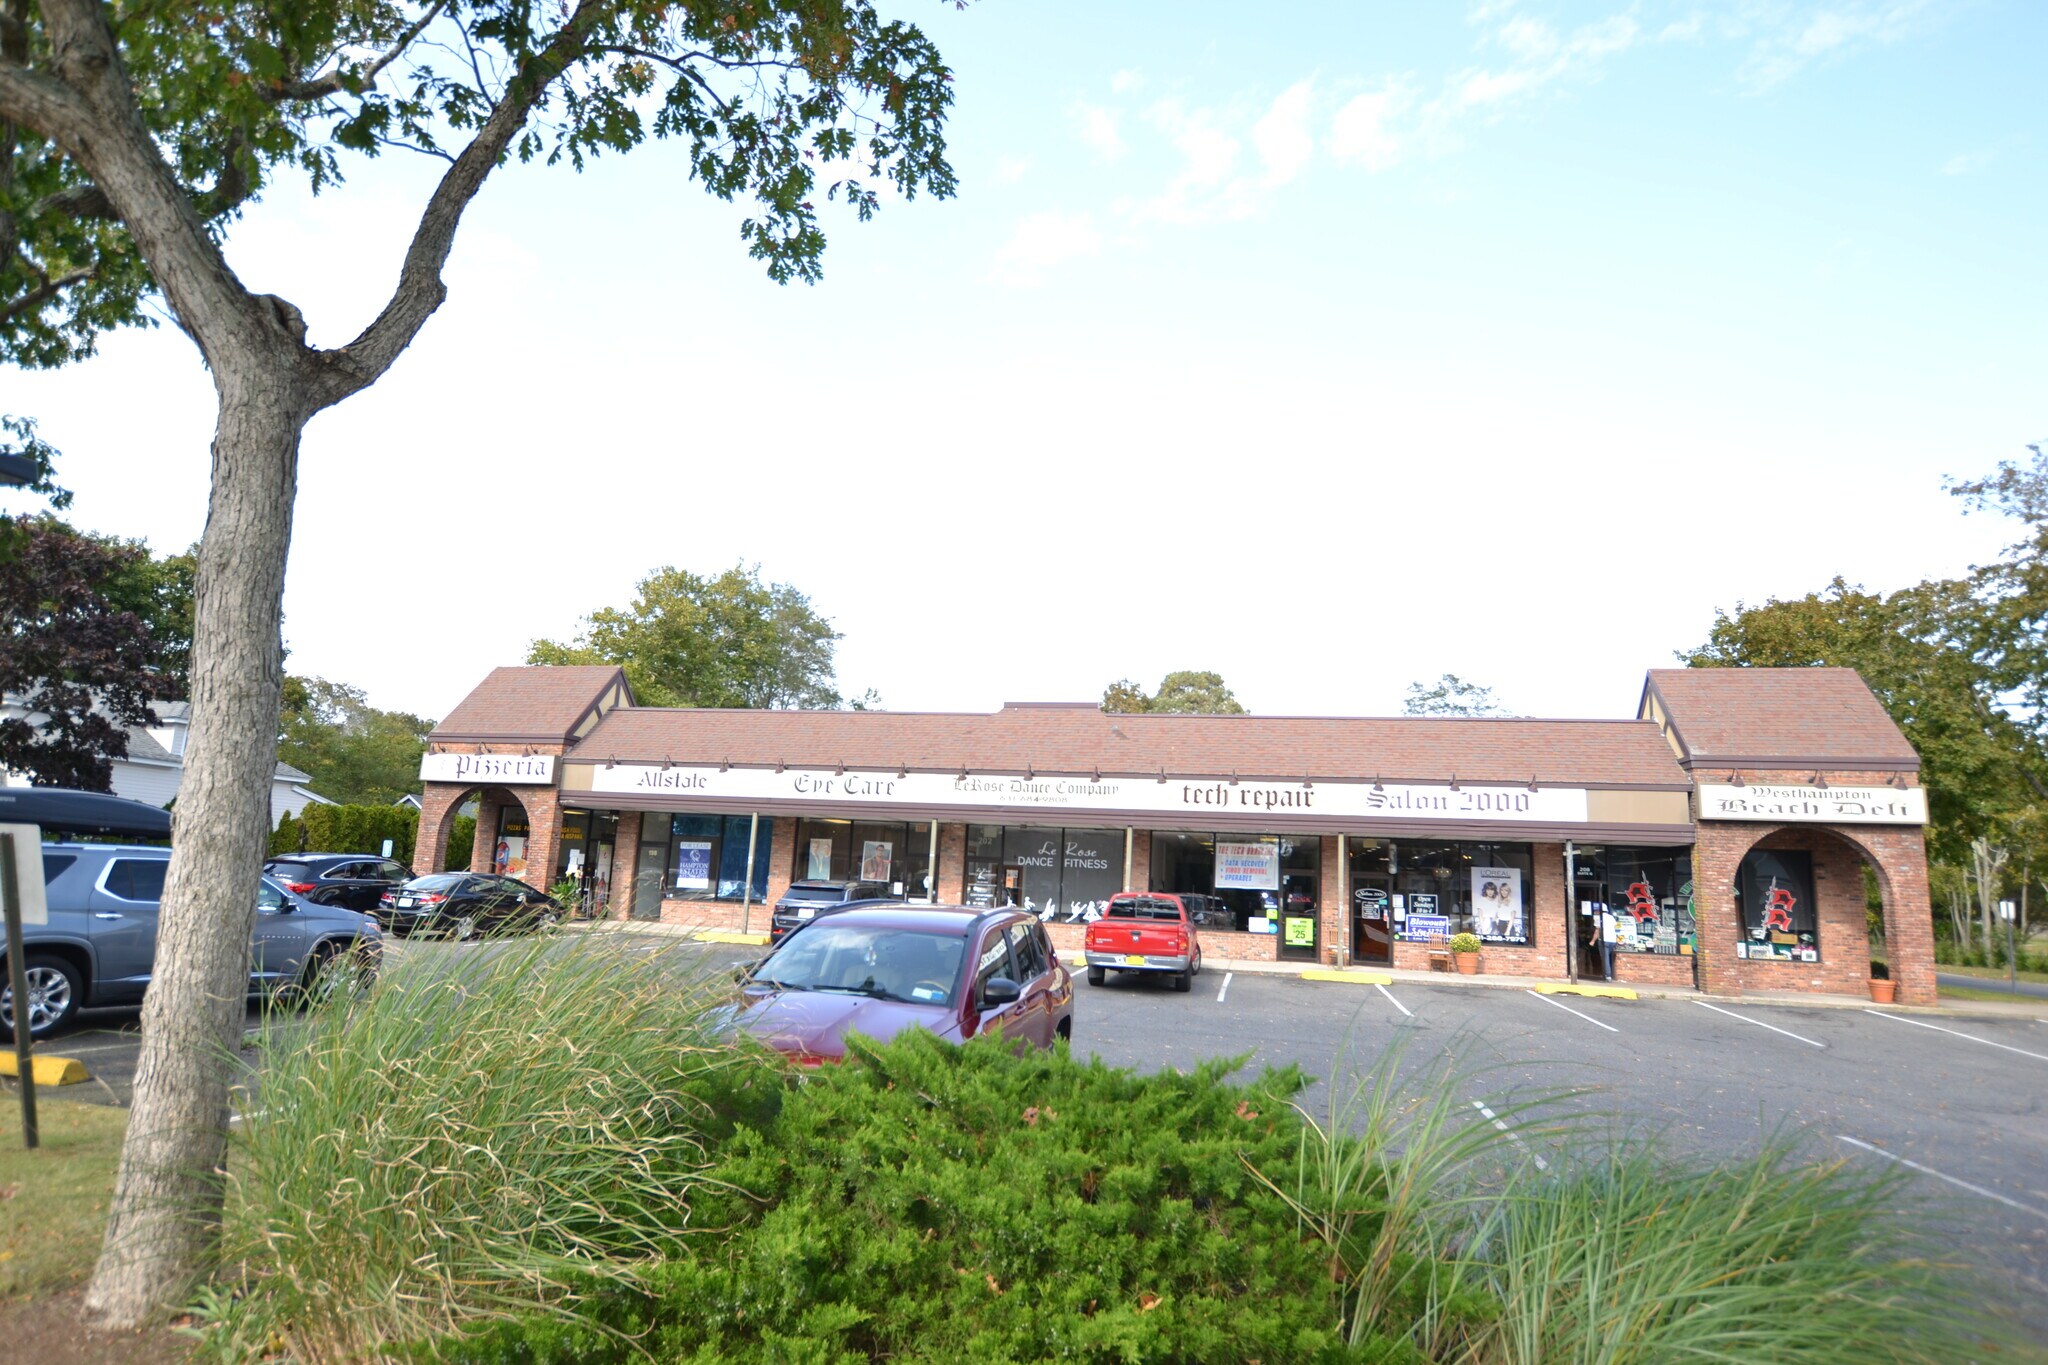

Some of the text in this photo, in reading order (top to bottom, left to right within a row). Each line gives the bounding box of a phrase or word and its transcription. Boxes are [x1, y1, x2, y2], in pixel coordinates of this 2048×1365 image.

[456, 756, 545, 779] Pizzeria
[636, 771, 707, 788] Allstate
[794, 774, 894, 795] Eye Care
[953, 778, 1119, 796] LeRose Dance Company
[1183, 784, 1315, 811] tech repair
[1366, 790, 1529, 812] Salon 2000
[1751, 786, 1872, 800] Westhampton
[1717, 798, 1908, 816] Beach Deli
[1038, 841, 1097, 857] Le Rose
[1017, 856, 1108, 869] DANCE FITNESS
[1410, 917, 1446, 926] Blowouts
[1295, 930, 1306, 939] 25
